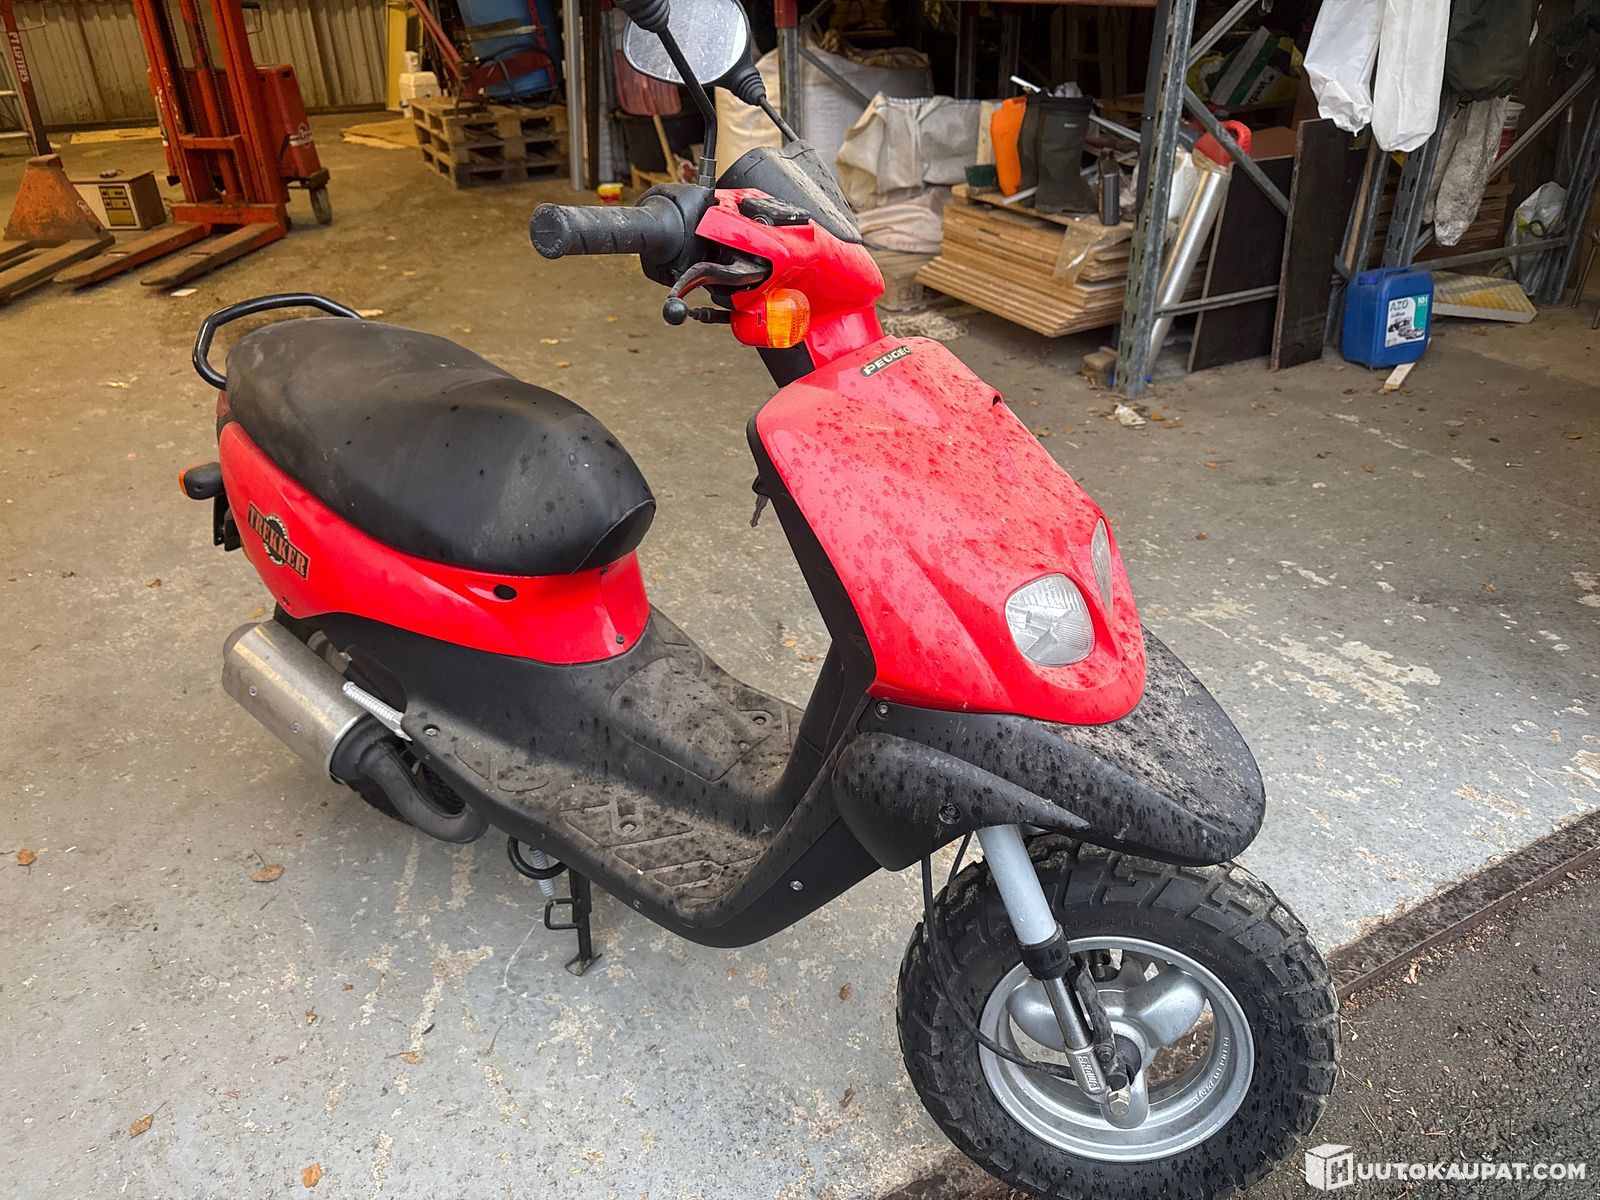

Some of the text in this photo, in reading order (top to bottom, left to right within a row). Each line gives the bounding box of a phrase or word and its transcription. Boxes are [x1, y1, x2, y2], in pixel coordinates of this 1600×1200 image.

[1390, 300, 1409, 311] AZO
[863, 346, 911, 375] PEUGEO
[248, 504, 307, 577] TREKKER
